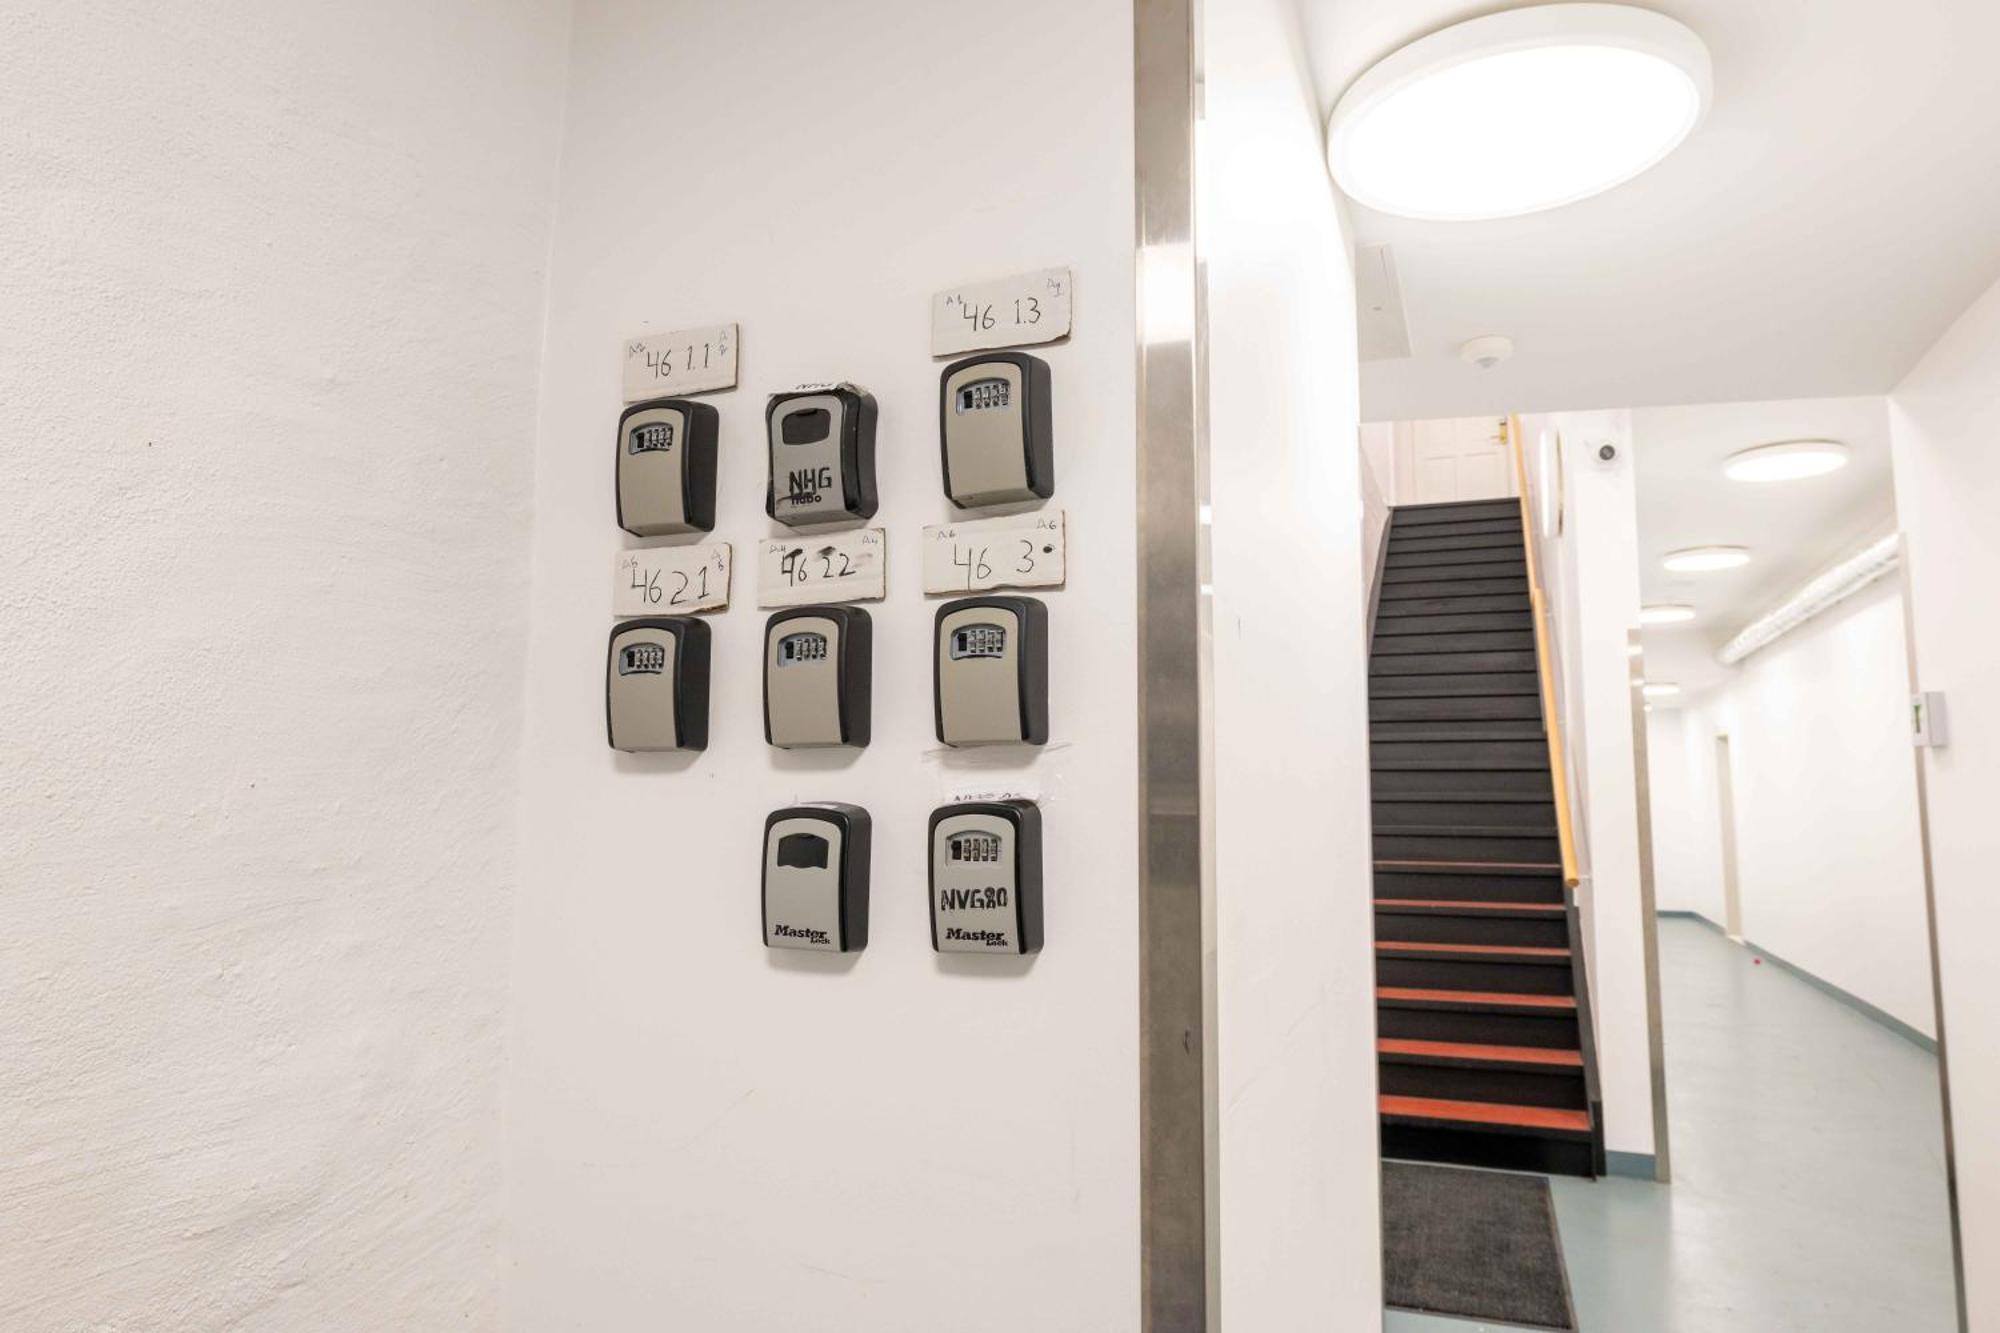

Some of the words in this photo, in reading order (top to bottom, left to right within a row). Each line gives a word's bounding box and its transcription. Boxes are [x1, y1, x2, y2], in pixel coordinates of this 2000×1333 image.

[963, 303, 996, 332] 46
[1014, 296, 1041, 324] 1.3
[647, 349, 672, 379] 46
[687, 343, 709, 370] 1.1
[789, 467, 832, 496] NHG
[781, 551, 807, 587] 46
[822, 552, 856, 578] 22
[954, 543, 992, 591] 46
[631, 567, 662, 604] 46
[940, 887, 1008, 911] NVG80
[774, 925, 827, 939] Master
[810, 937, 831, 945] Lock
[945, 928, 1005, 941] Master
[985, 939, 1008, 947] Lock
